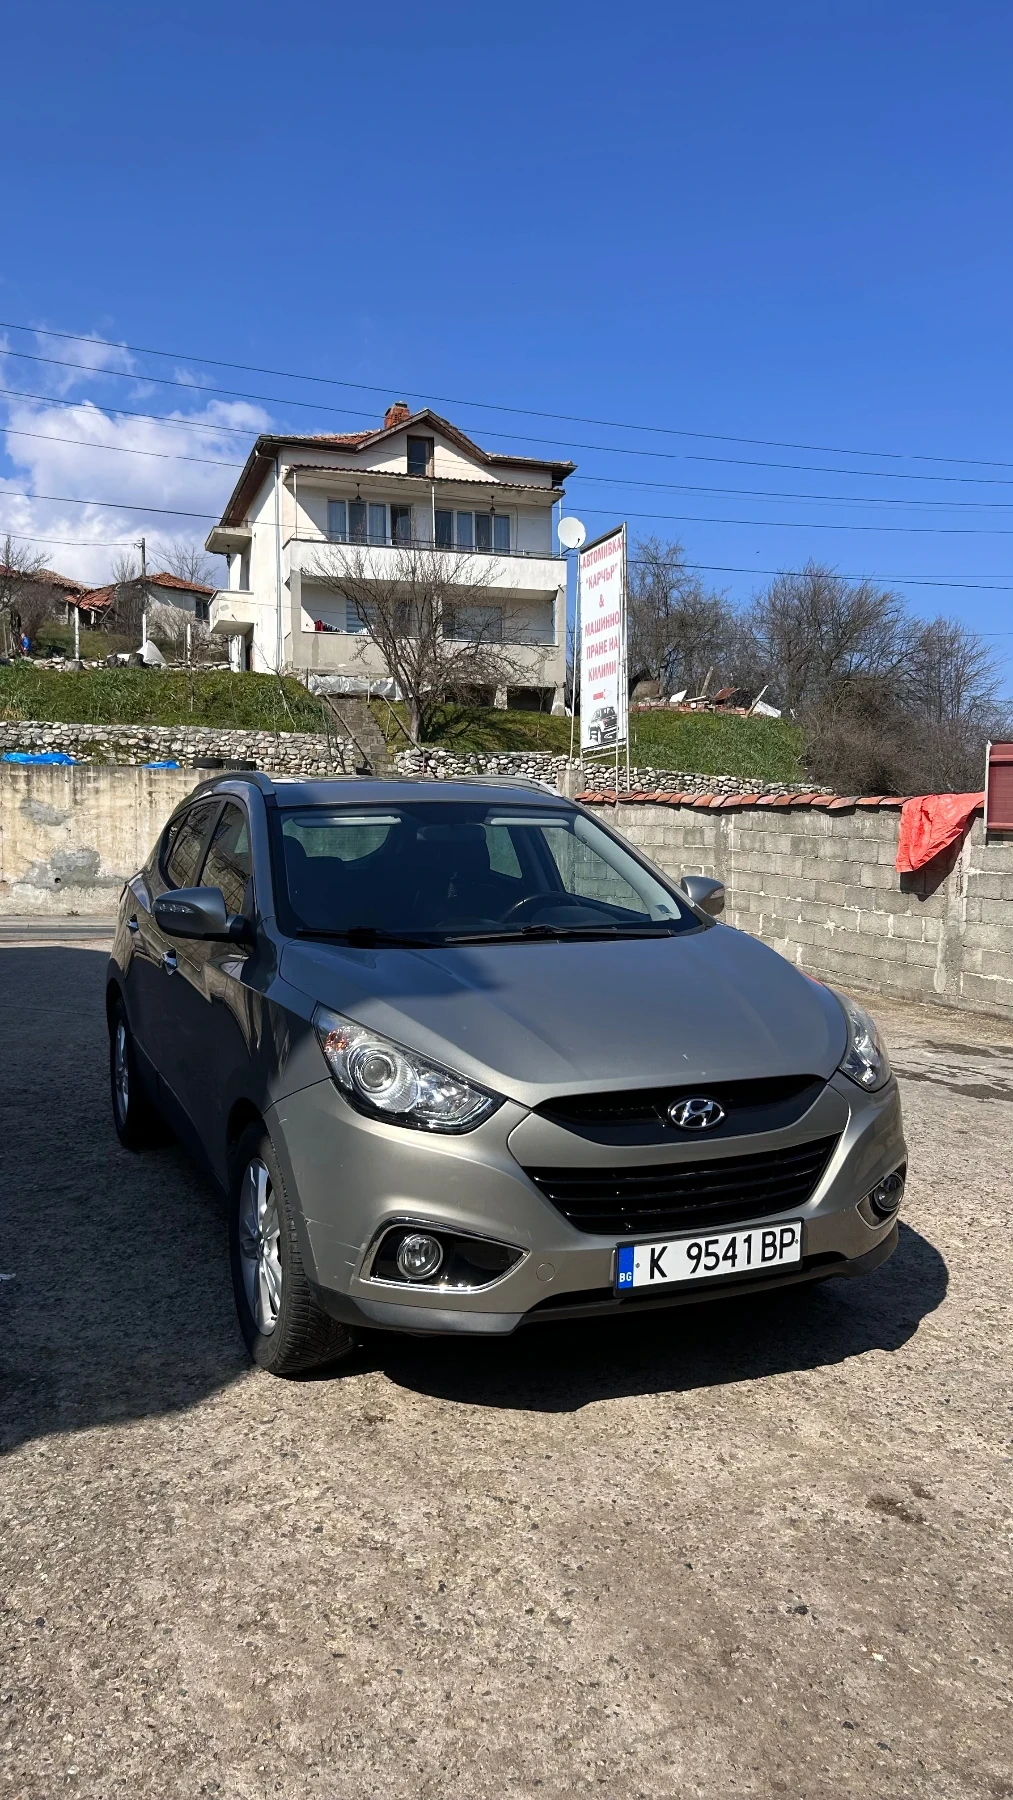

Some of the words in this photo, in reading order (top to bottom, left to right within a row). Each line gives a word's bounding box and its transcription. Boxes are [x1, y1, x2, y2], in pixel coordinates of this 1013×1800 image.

[582, 536, 622, 569] АВТОМИВКА
[598, 593, 605, 608] &
[584, 610, 620, 638] МАШИННО
[586, 639, 608, 660] ПРАНЕ
[609, 635, 619, 652] НА
[588, 659, 617, 682] КИЛИМИ
[619, 1271, 633, 1283] BG
